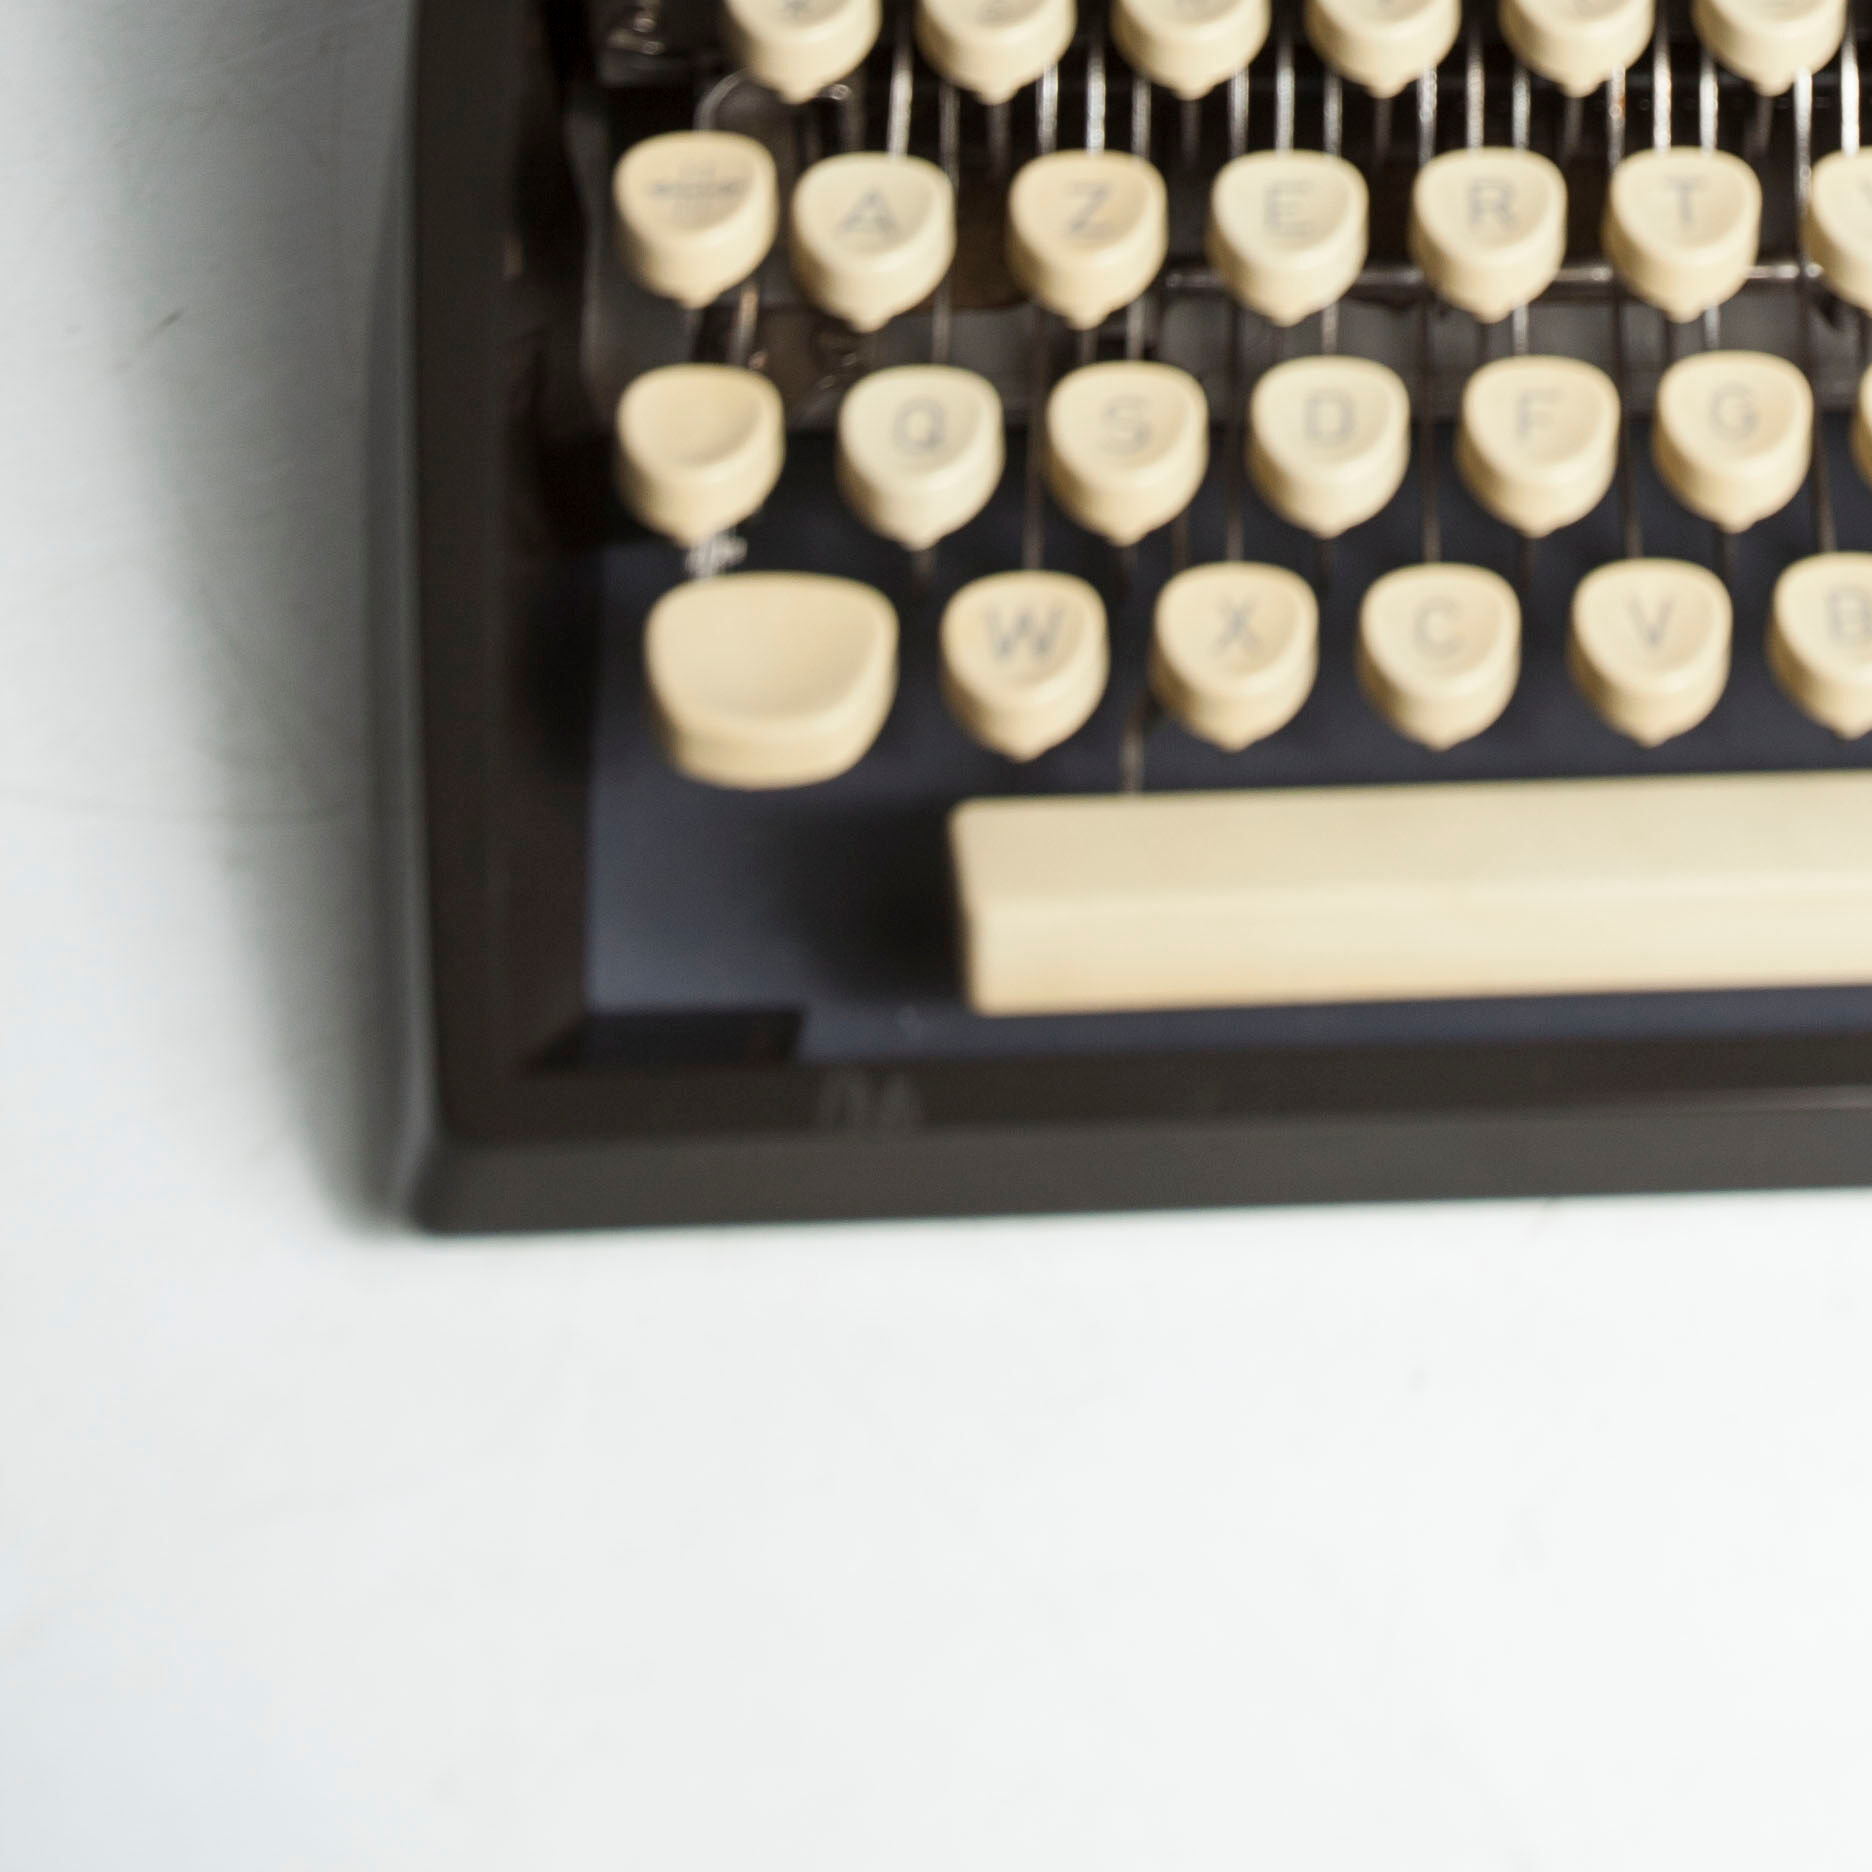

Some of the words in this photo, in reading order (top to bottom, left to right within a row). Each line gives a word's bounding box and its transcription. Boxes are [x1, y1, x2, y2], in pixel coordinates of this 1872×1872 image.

[841, 189, 897, 236] A
[1068, 182, 1110, 234] Z
[1264, 181, 1312, 233] E
[1467, 181, 1521, 230] R
[1666, 178, 1711, 227] T
[892, 398, 948, 456] Q
[1101, 395, 1152, 450] S
[1303, 391, 1357, 443] D
[1515, 389, 1561, 439] F
[1710, 387, 1761, 439] G
[983, 604, 1066, 659] W
[1214, 601, 1261, 654] X
[1412, 600, 1458, 654] C
[1628, 597, 1674, 648] V
